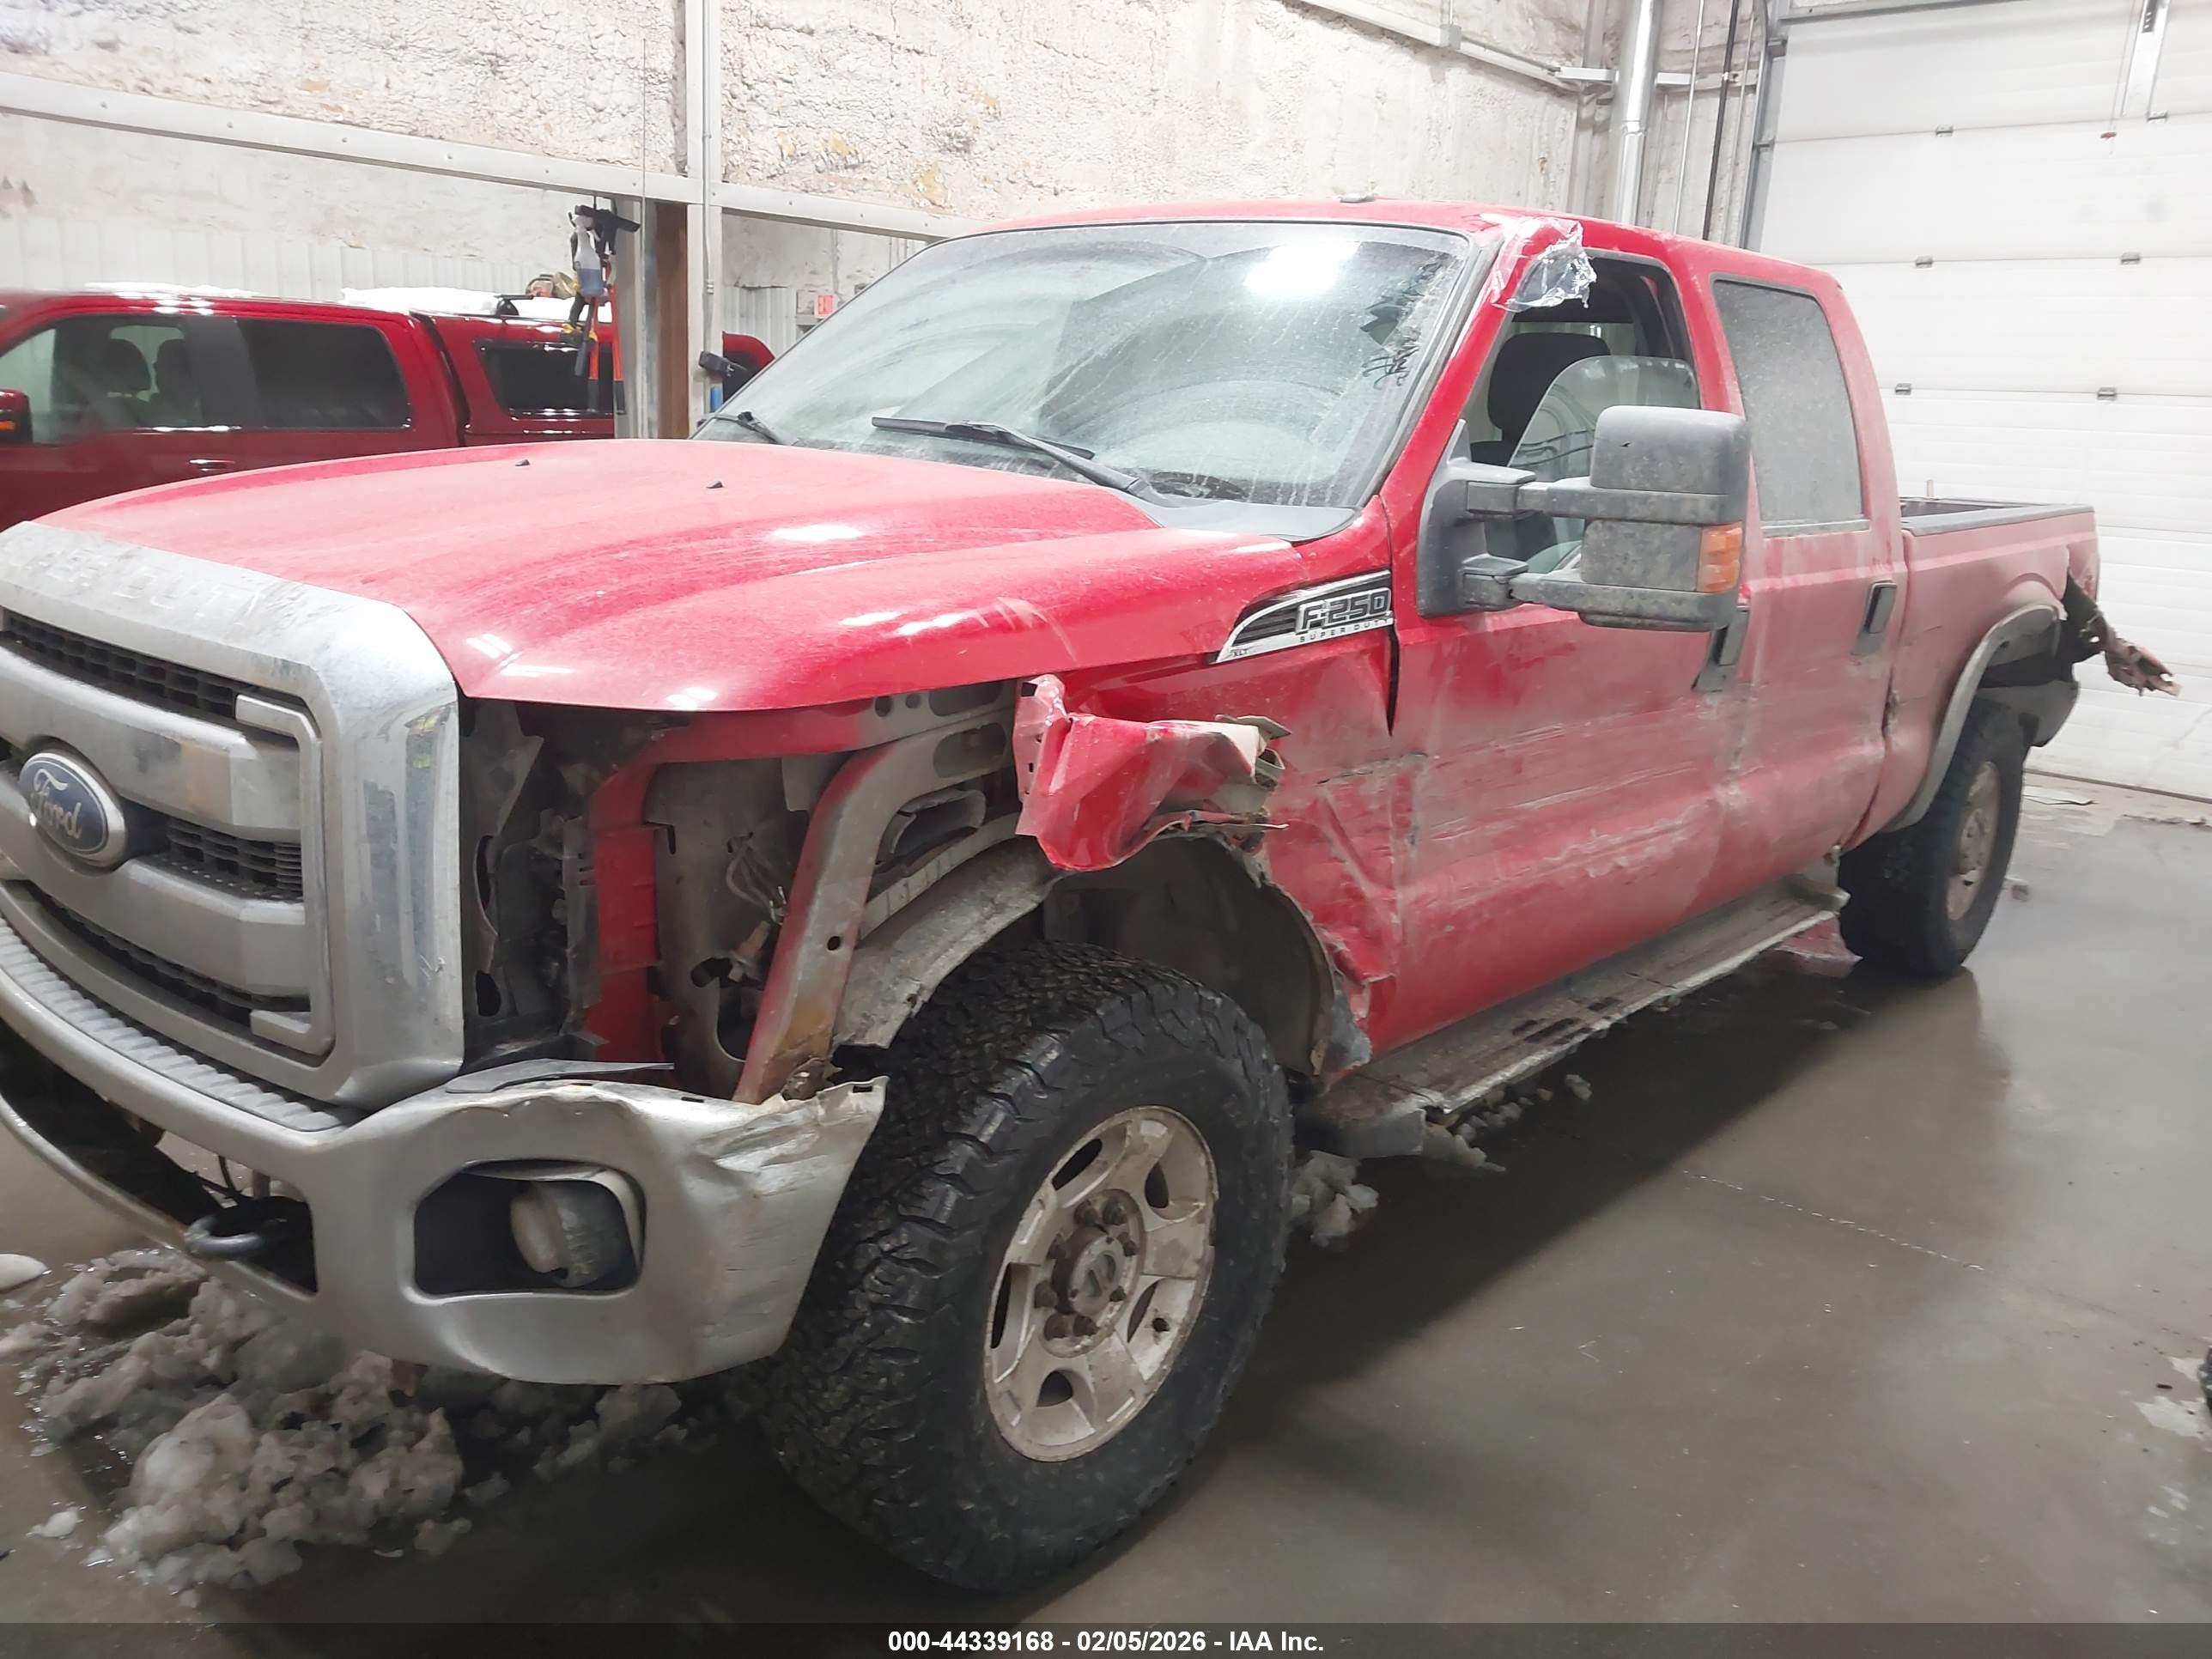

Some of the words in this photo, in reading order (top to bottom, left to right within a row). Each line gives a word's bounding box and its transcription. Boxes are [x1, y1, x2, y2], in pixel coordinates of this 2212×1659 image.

[1299, 626, 1346, 643] SUPER
[1353, 616, 1390, 631] DUTY
[31, 769, 82, 839] Ford
